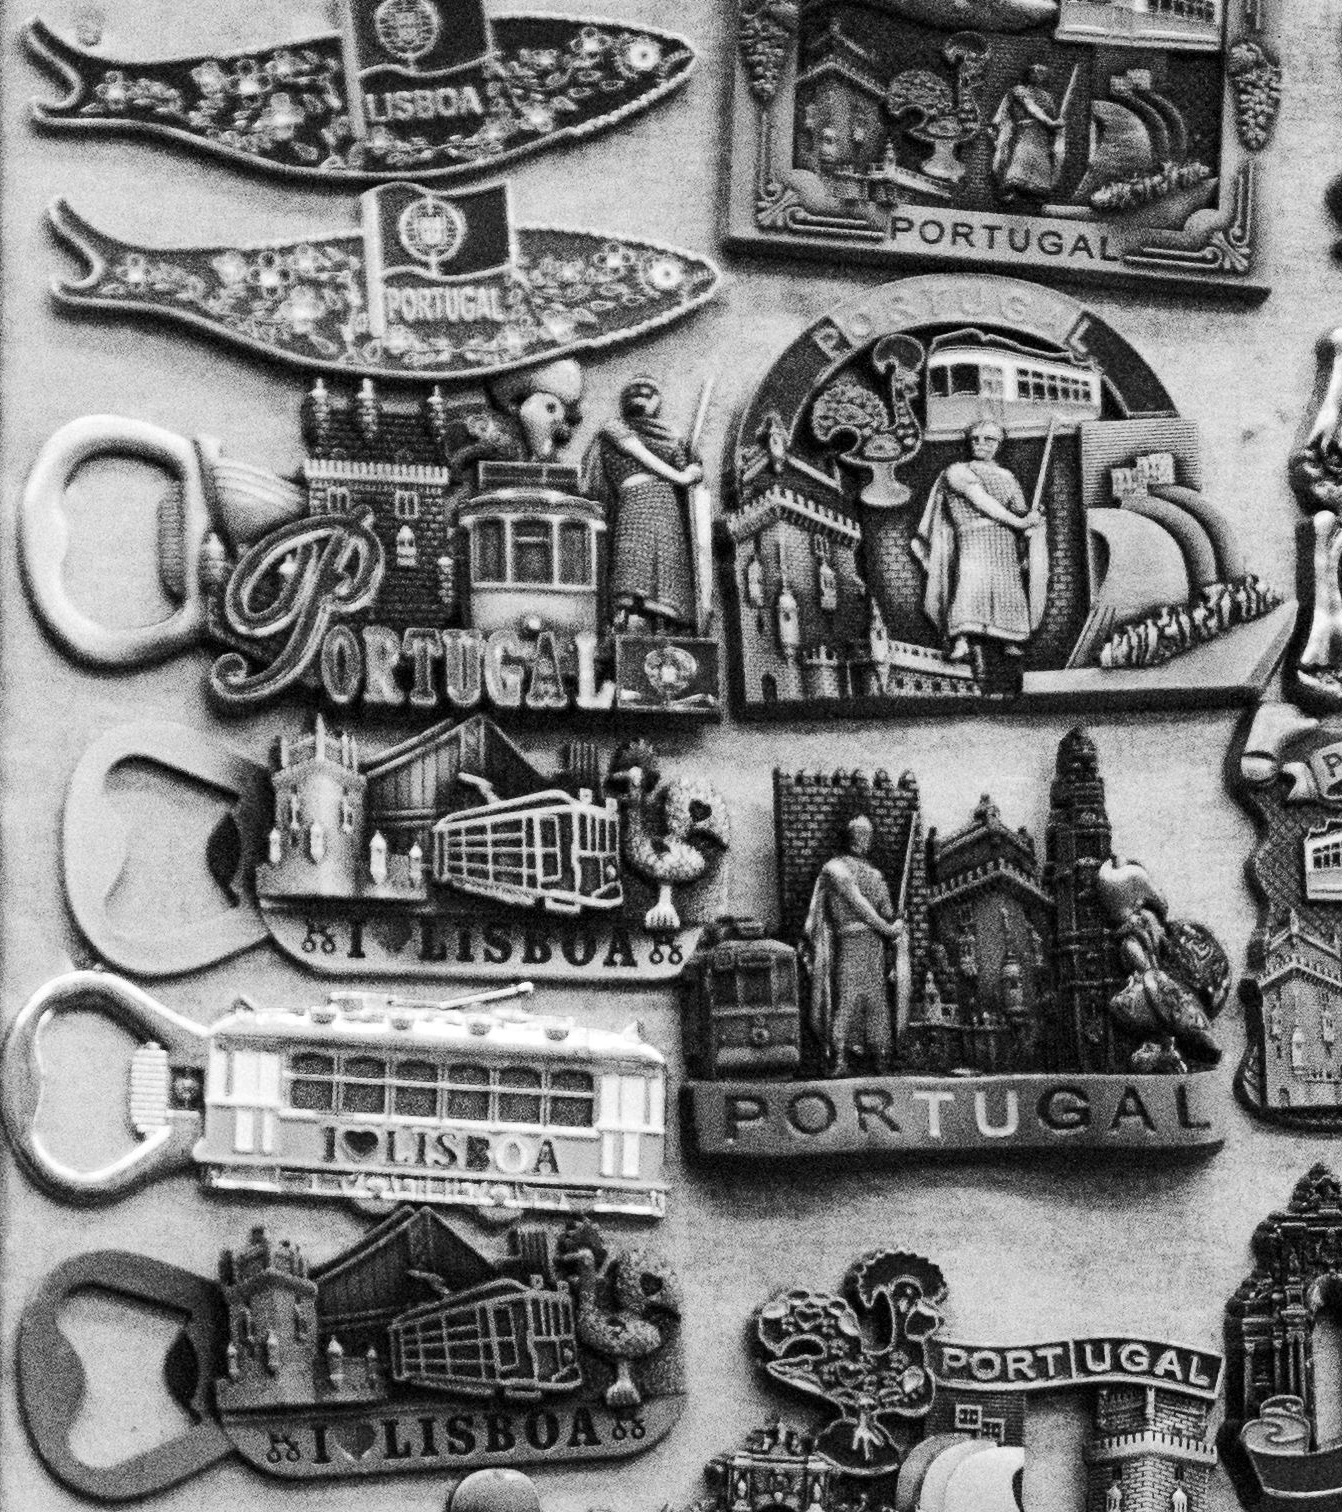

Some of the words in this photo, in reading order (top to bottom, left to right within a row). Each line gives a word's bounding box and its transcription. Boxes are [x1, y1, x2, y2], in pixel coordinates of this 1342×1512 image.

[366, 86, 482, 123] LISBOA
[890, 214, 1120, 262] PORTUGAL
[387, 286, 504, 322] PORTUGAL
[346, 922, 366, 959] I
[417, 921, 639, 968] LISBOA
[727, 1084, 1212, 1141] PORTUGAL
[384, 1126, 560, 1174] LISBOA
[941, 1344, 1213, 1388] PORTUGAL
[312, 1427, 332, 1464] I
[382, 1406, 603, 1460] LISBOA
